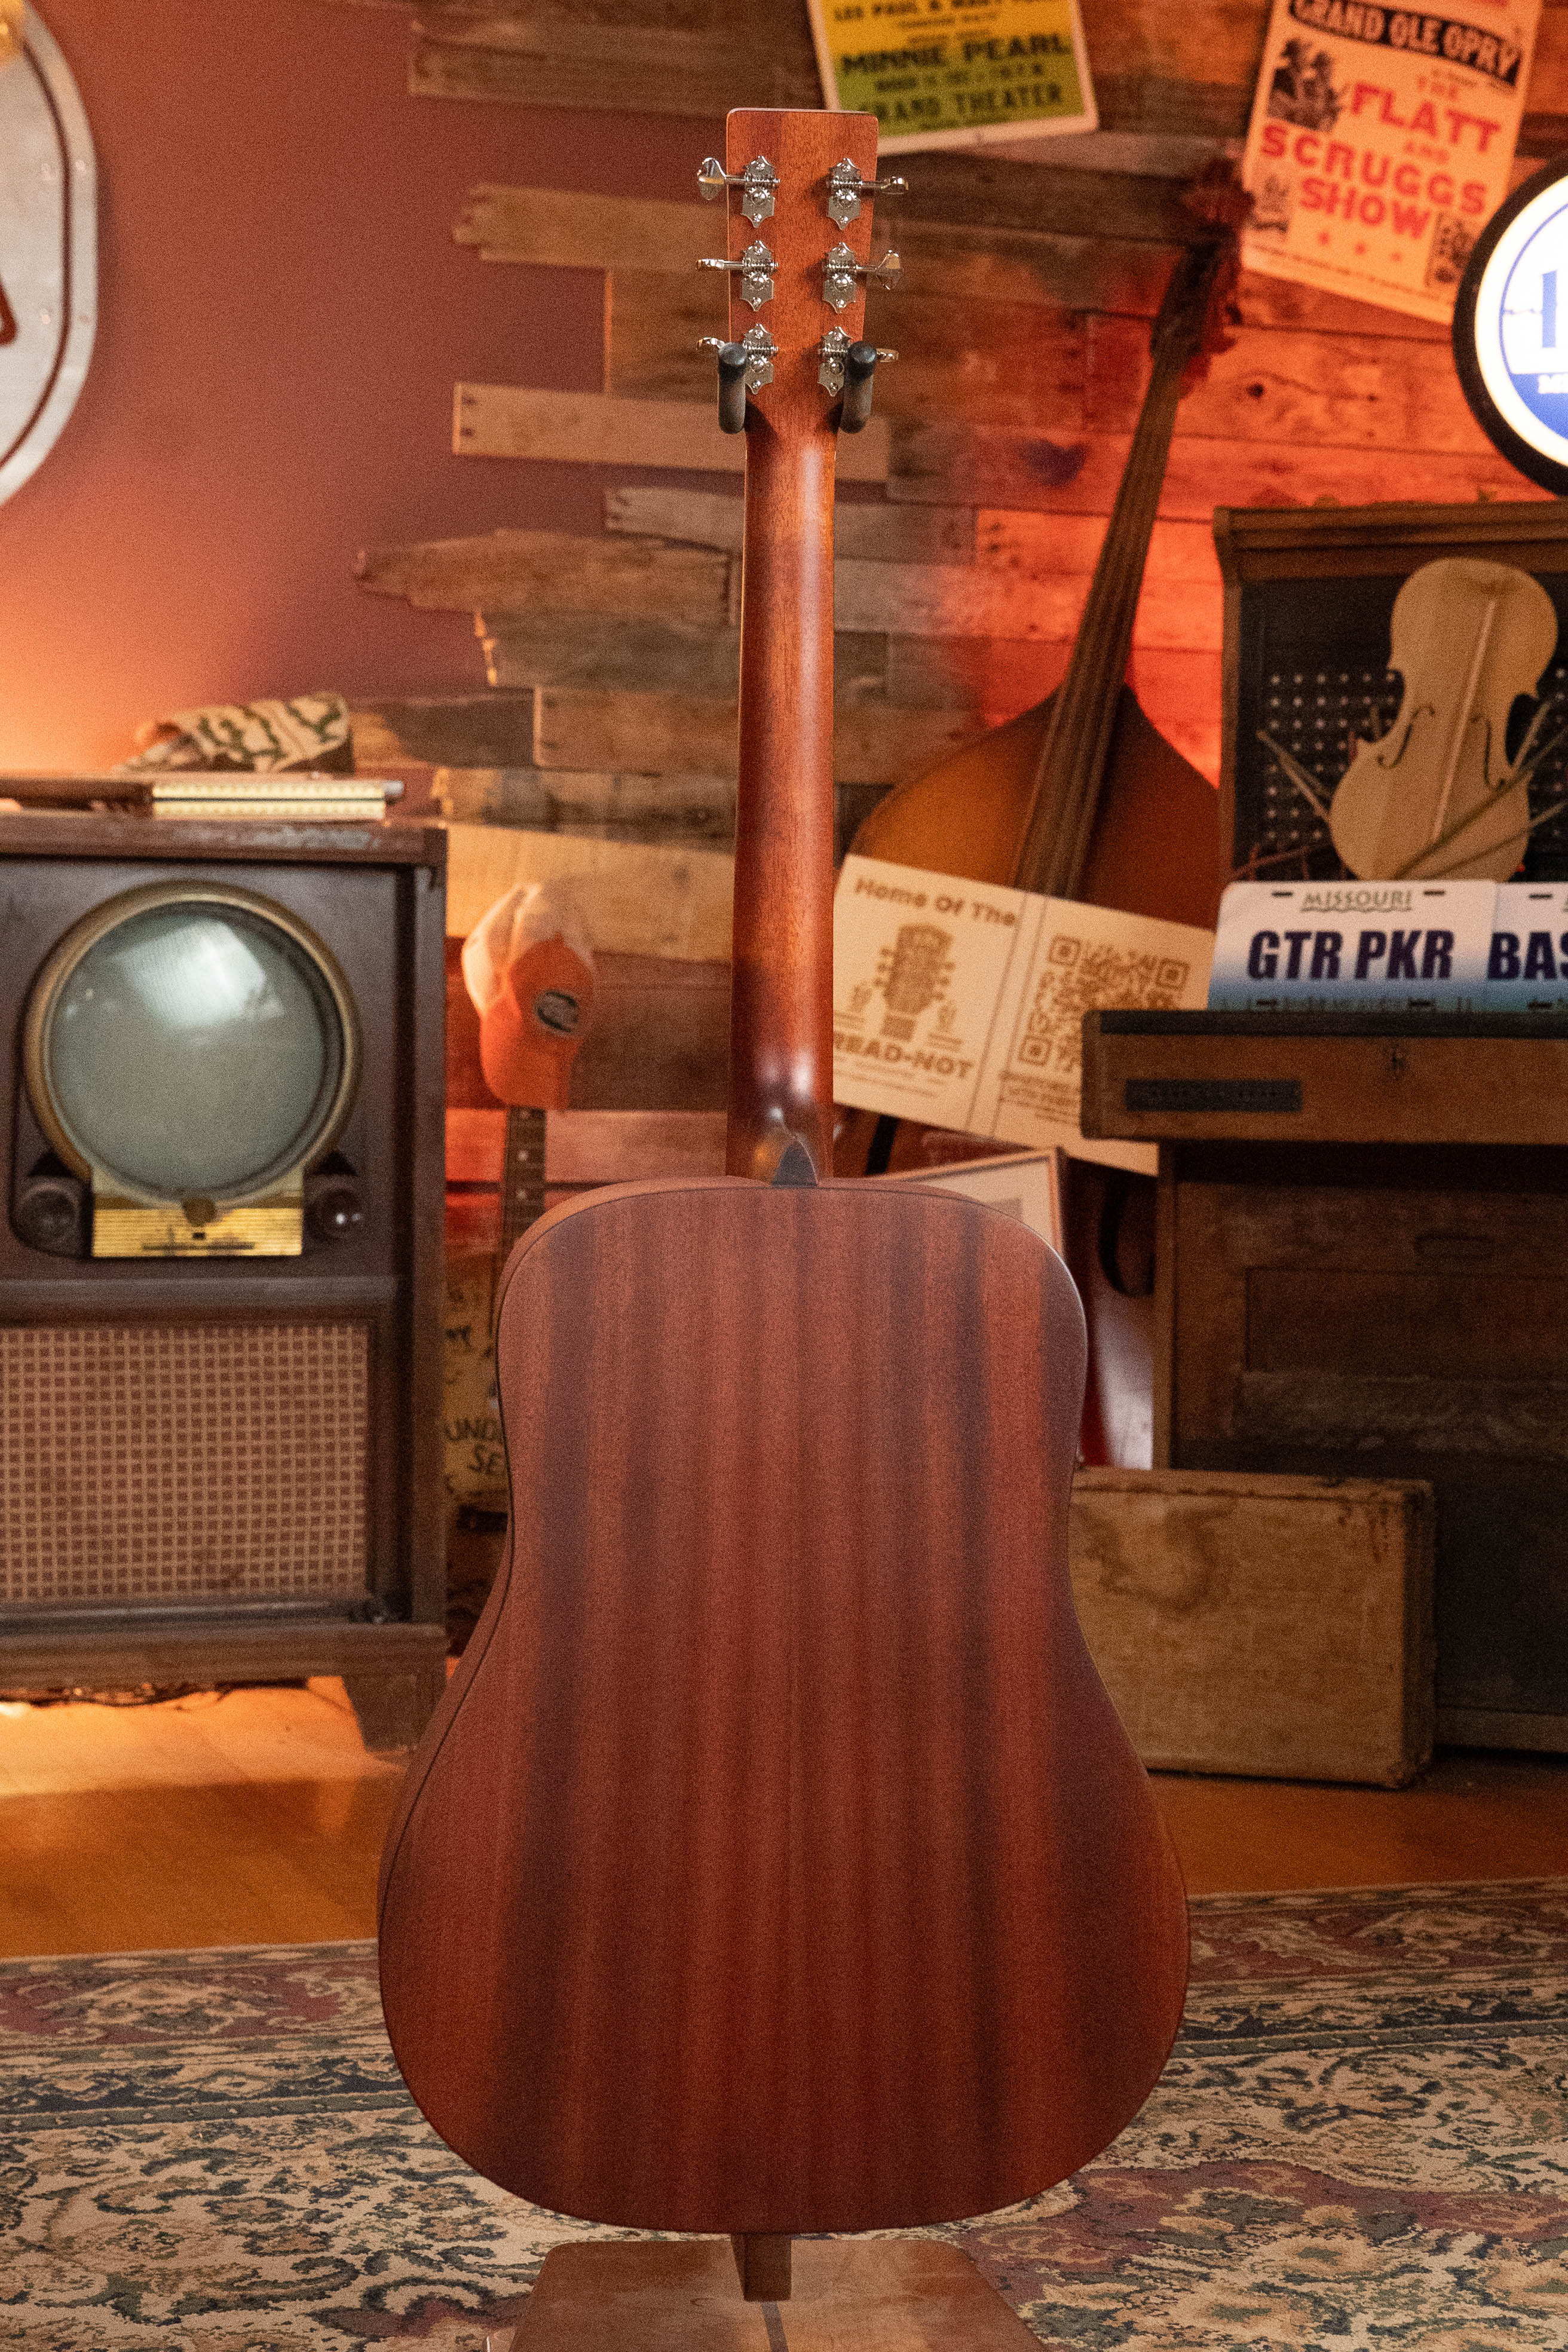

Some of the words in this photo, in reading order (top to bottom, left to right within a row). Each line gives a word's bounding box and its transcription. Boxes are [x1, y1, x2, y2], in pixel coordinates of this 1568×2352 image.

[841, 45, 947, 74] MINNIE
[963, 33, 1070, 60] PEARL
[1389, 16, 1438, 51] OLE
[1443, 25, 1521, 80] OPRY
[954, 82, 1064, 115] THEATER
[1351, 81, 1502, 154] FLATT
[1260, 124, 1487, 216] SCRUGGS
[1299, 176, 1433, 240] SHOW
[855, 878, 926, 908] Home
[934, 893, 966, 914] Of
[972, 904, 1017, 927] The
[1301, 889, 1411, 907] MISSOURI
[1247, 929, 1343, 979] GTR
[1354, 929, 1454, 979] PKR
